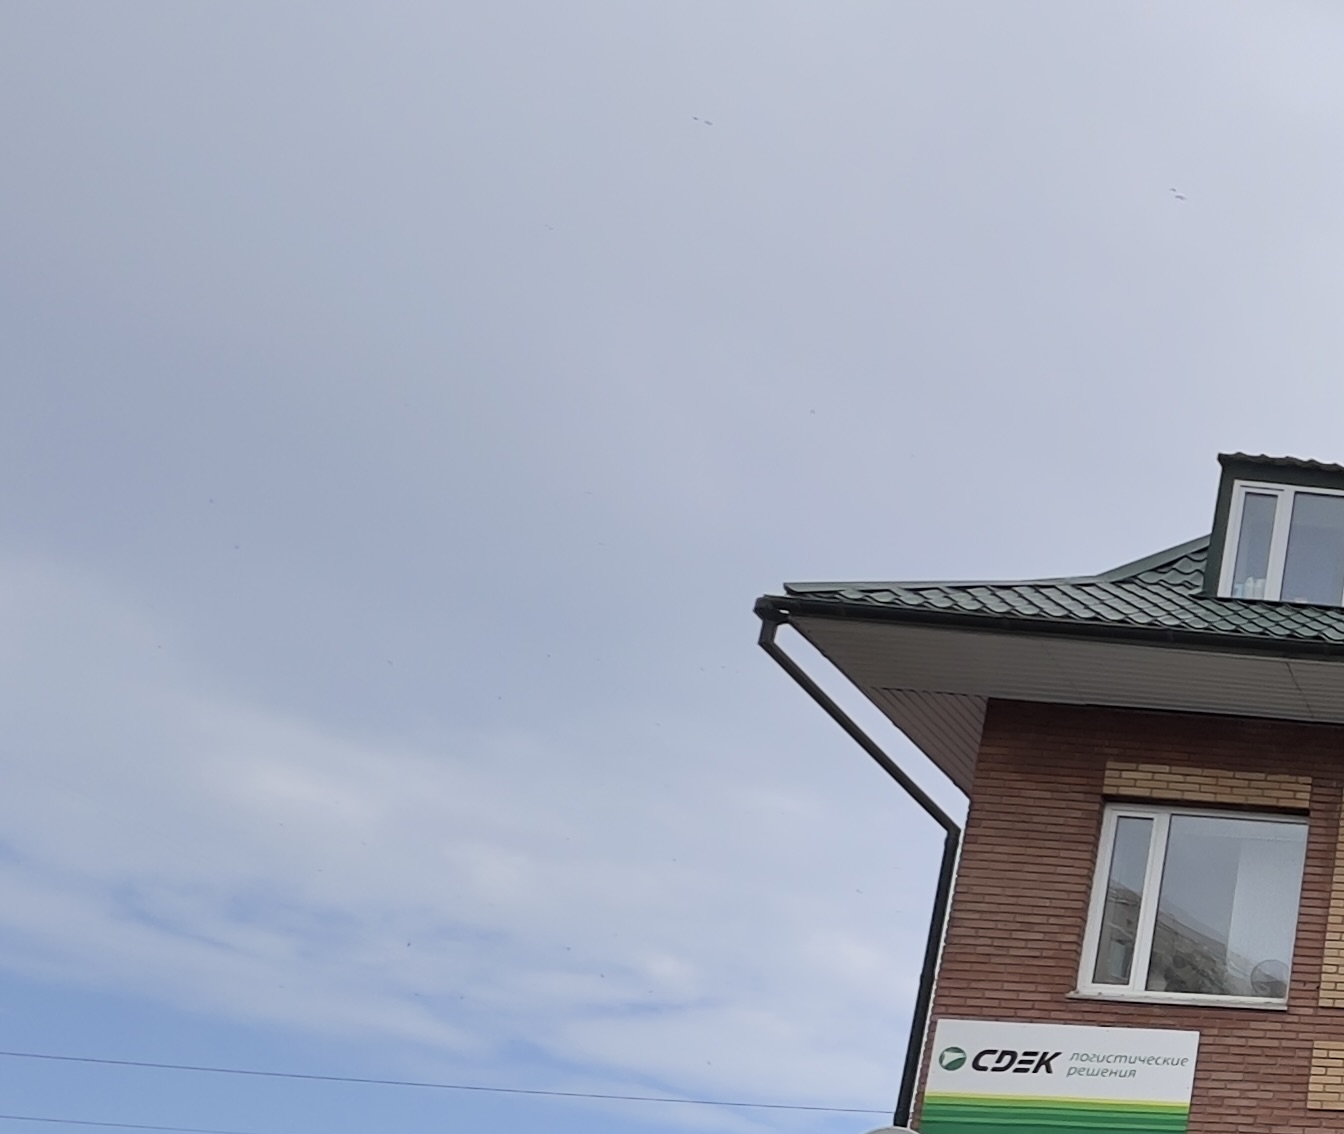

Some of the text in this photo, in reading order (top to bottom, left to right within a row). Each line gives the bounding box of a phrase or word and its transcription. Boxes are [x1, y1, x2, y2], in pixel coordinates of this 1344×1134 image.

[971, 1049, 1062, 1074] CDEK
[1068, 1051, 1190, 1067] логистические
[1066, 1067, 1137, 1078] решения
